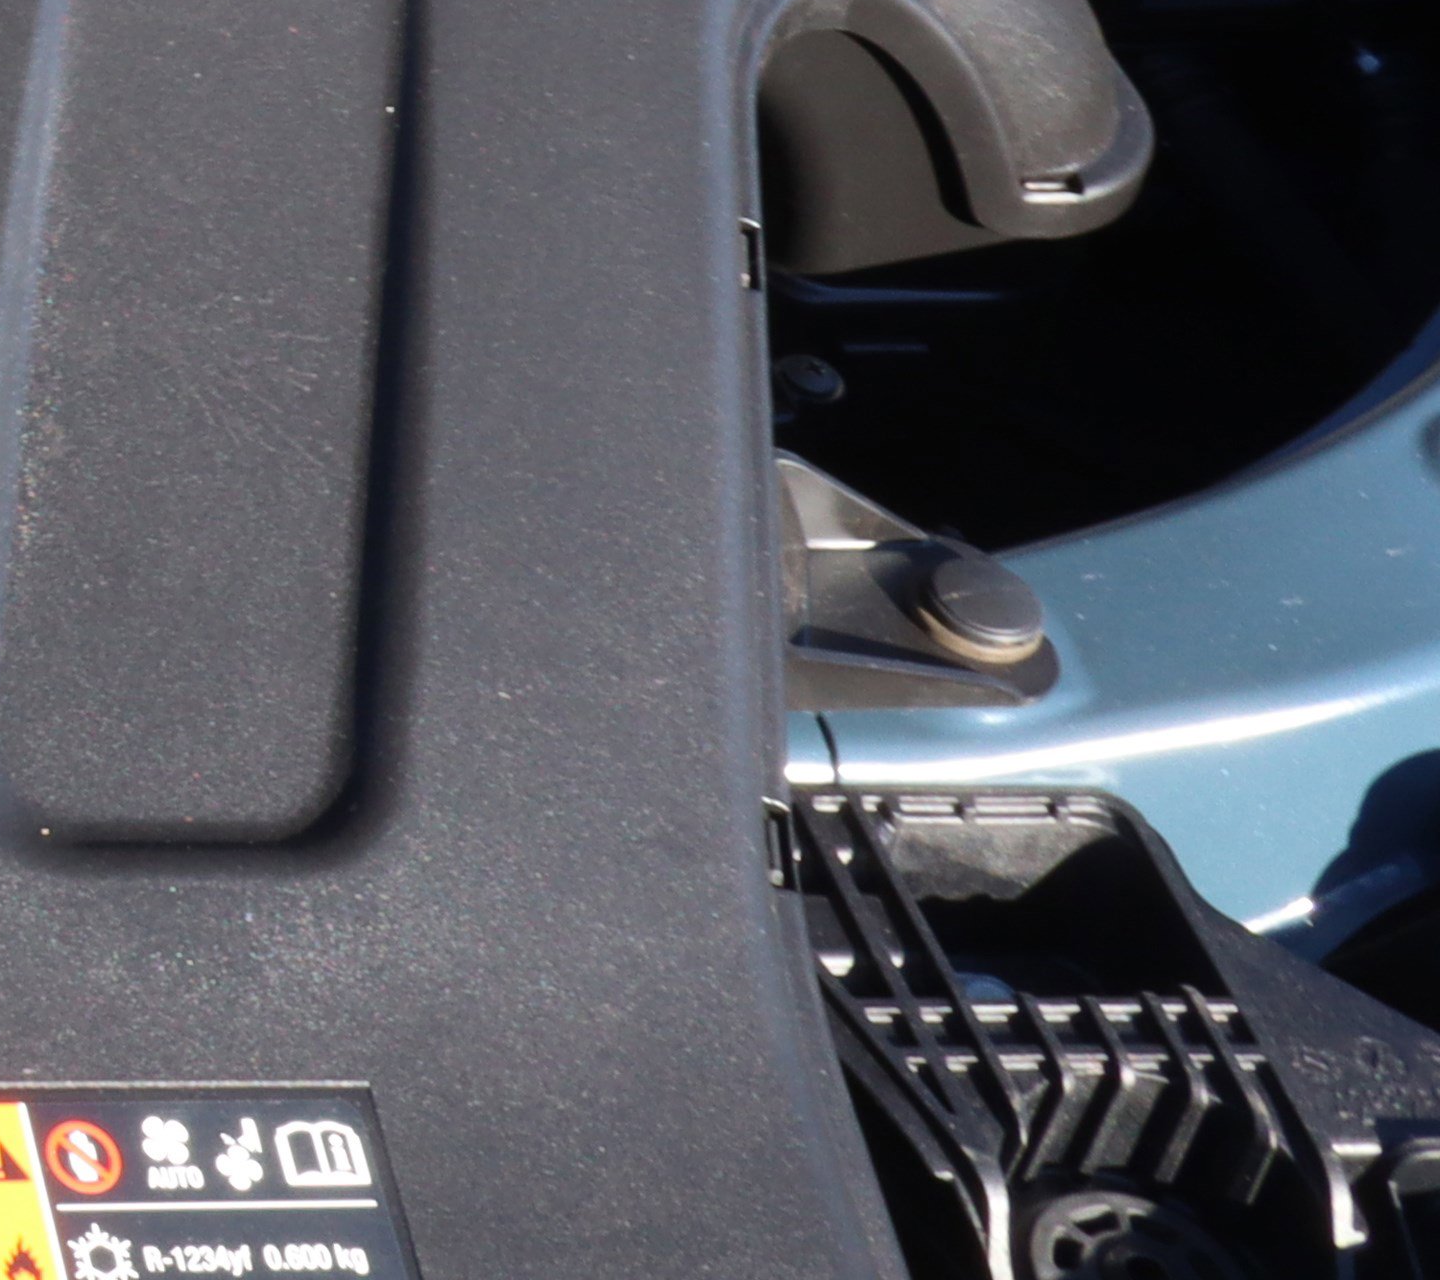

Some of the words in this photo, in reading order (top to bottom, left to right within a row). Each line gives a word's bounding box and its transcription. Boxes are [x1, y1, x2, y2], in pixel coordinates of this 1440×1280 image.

[147, 1165, 205, 1191] AUTO
[142, 1244, 254, 1277] R-1234yf
[333, 1244, 370, 1275] kg
